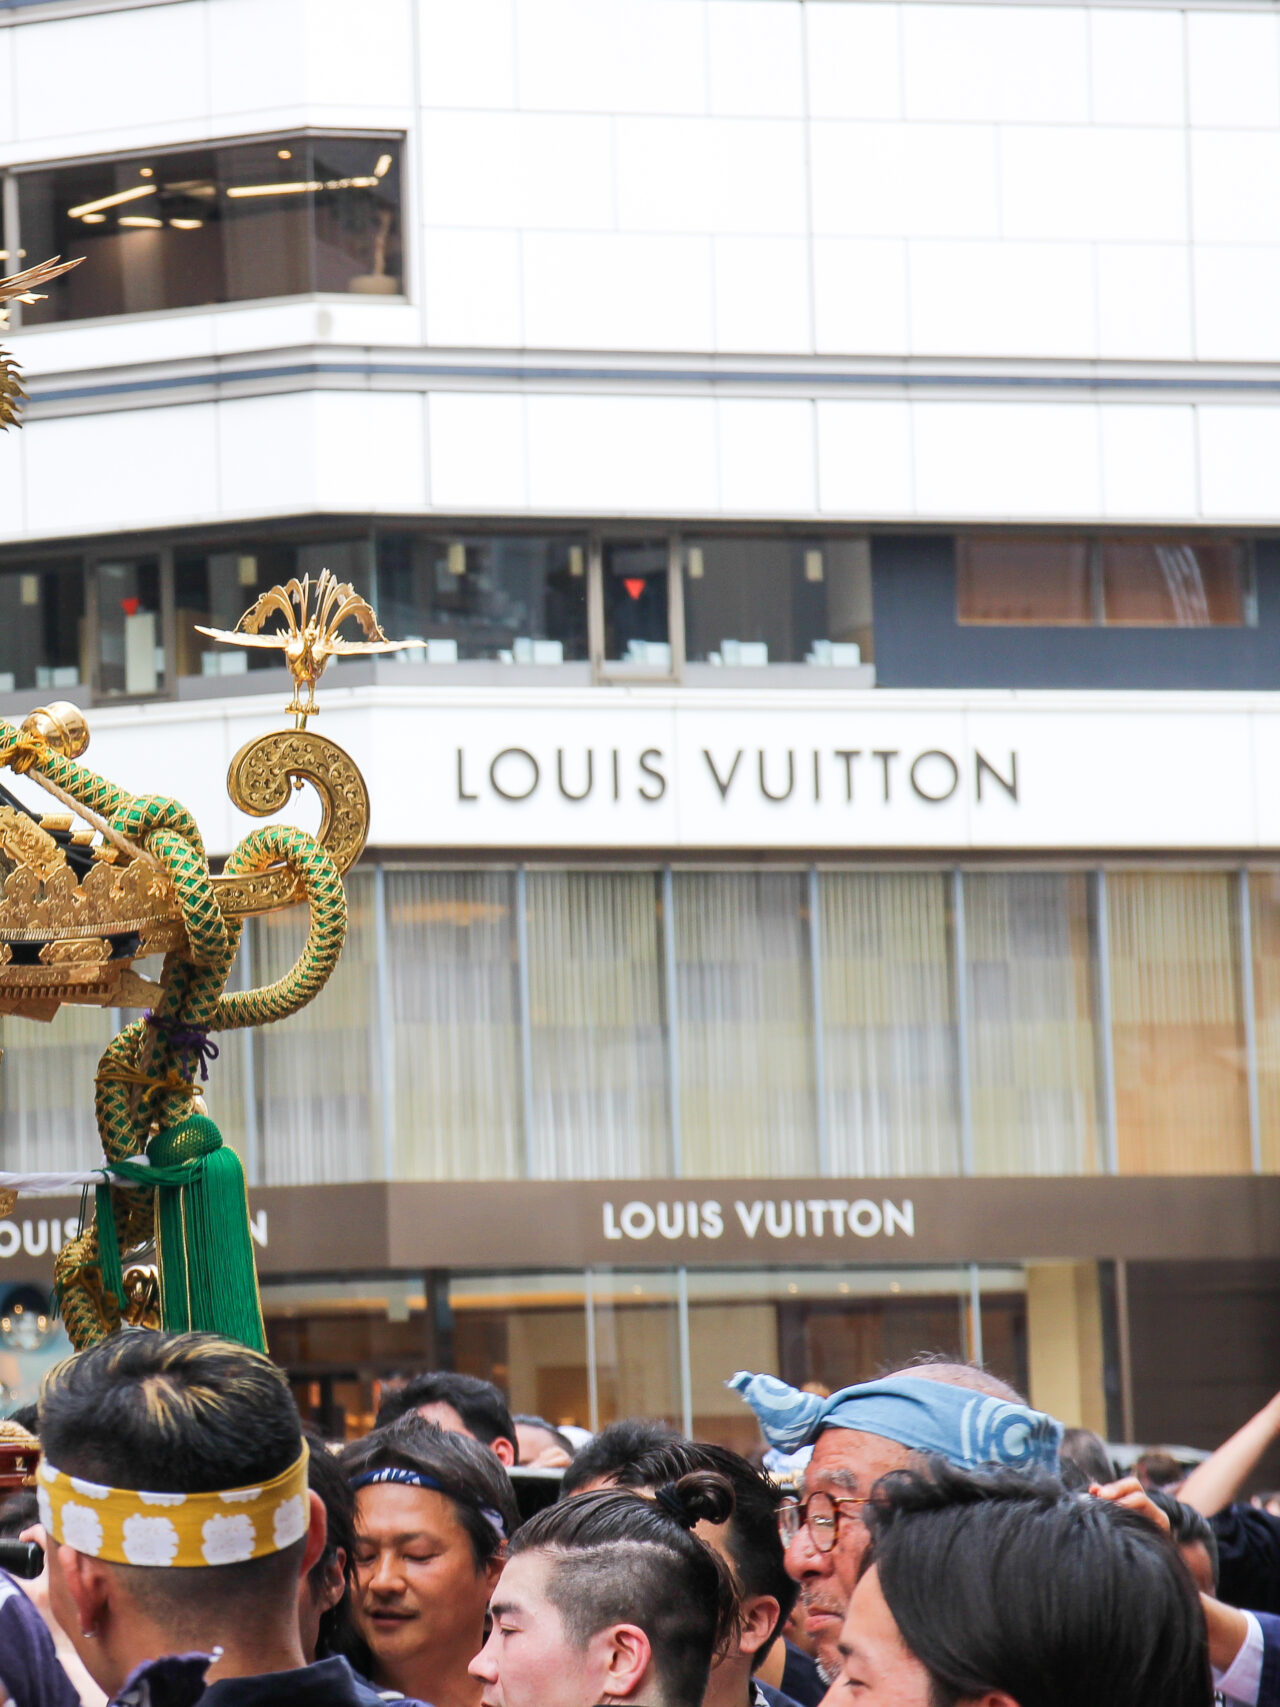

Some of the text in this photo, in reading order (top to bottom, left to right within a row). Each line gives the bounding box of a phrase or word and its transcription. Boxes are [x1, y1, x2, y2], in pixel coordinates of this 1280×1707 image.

[457, 747, 1019, 804] LOUIS VUITTON
[602, 1198, 915, 1240] LOUIS VUITTON
